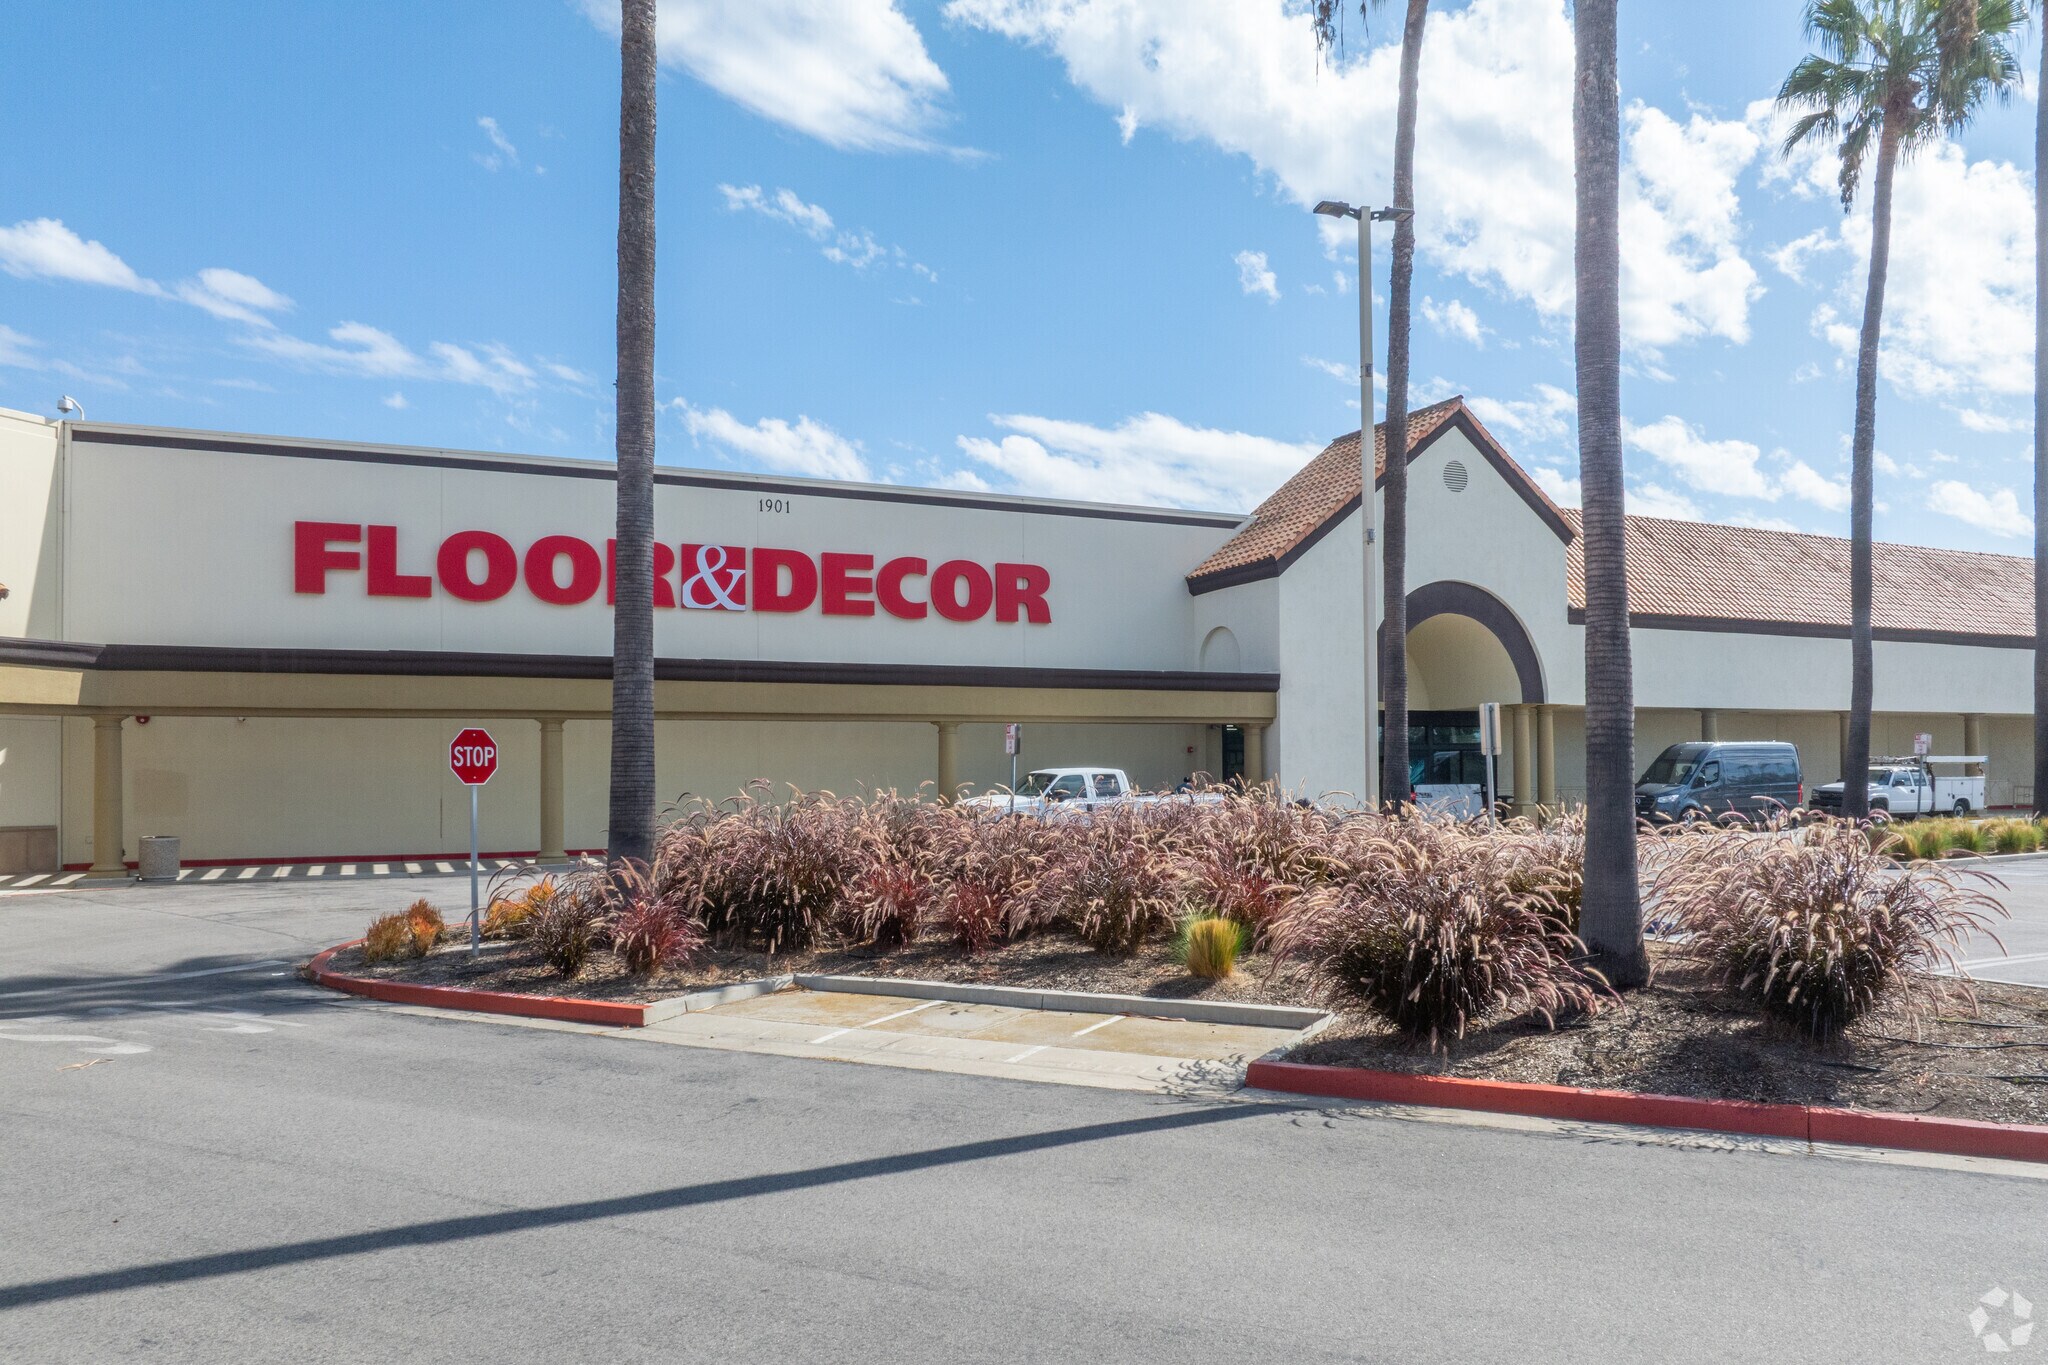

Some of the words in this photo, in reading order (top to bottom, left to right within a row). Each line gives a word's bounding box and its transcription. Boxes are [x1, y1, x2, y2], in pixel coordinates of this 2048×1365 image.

[759, 498, 790, 514] 1901
[752, 547, 1051, 623] DECOR
[453, 745, 495, 767] STOP
